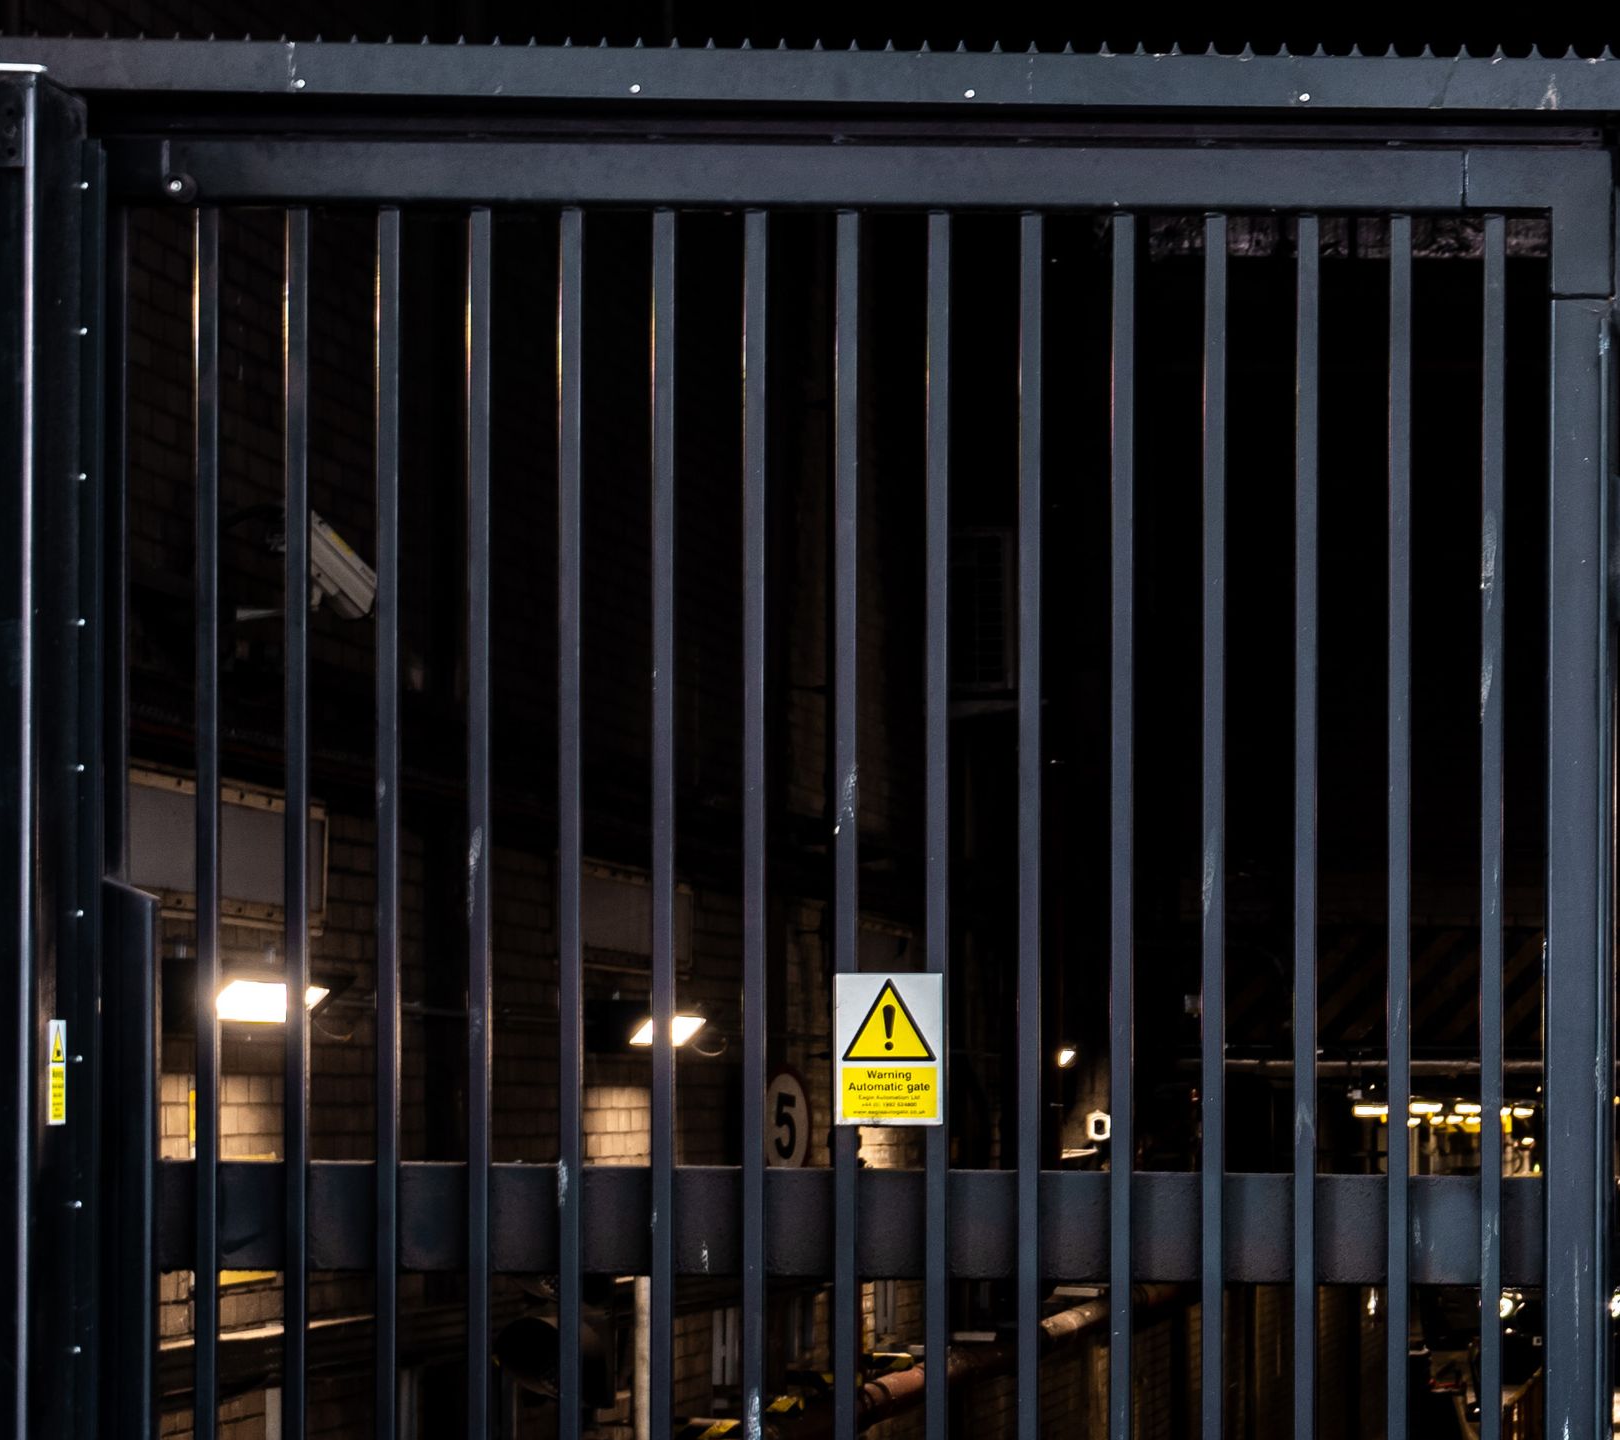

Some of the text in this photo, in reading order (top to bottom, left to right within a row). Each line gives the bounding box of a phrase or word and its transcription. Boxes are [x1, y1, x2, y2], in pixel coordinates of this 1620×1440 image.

[867, 1070, 912, 1081] Warning
[848, 1082, 930, 1093] Automatic gate
[775, 1092, 796, 1159] 5
